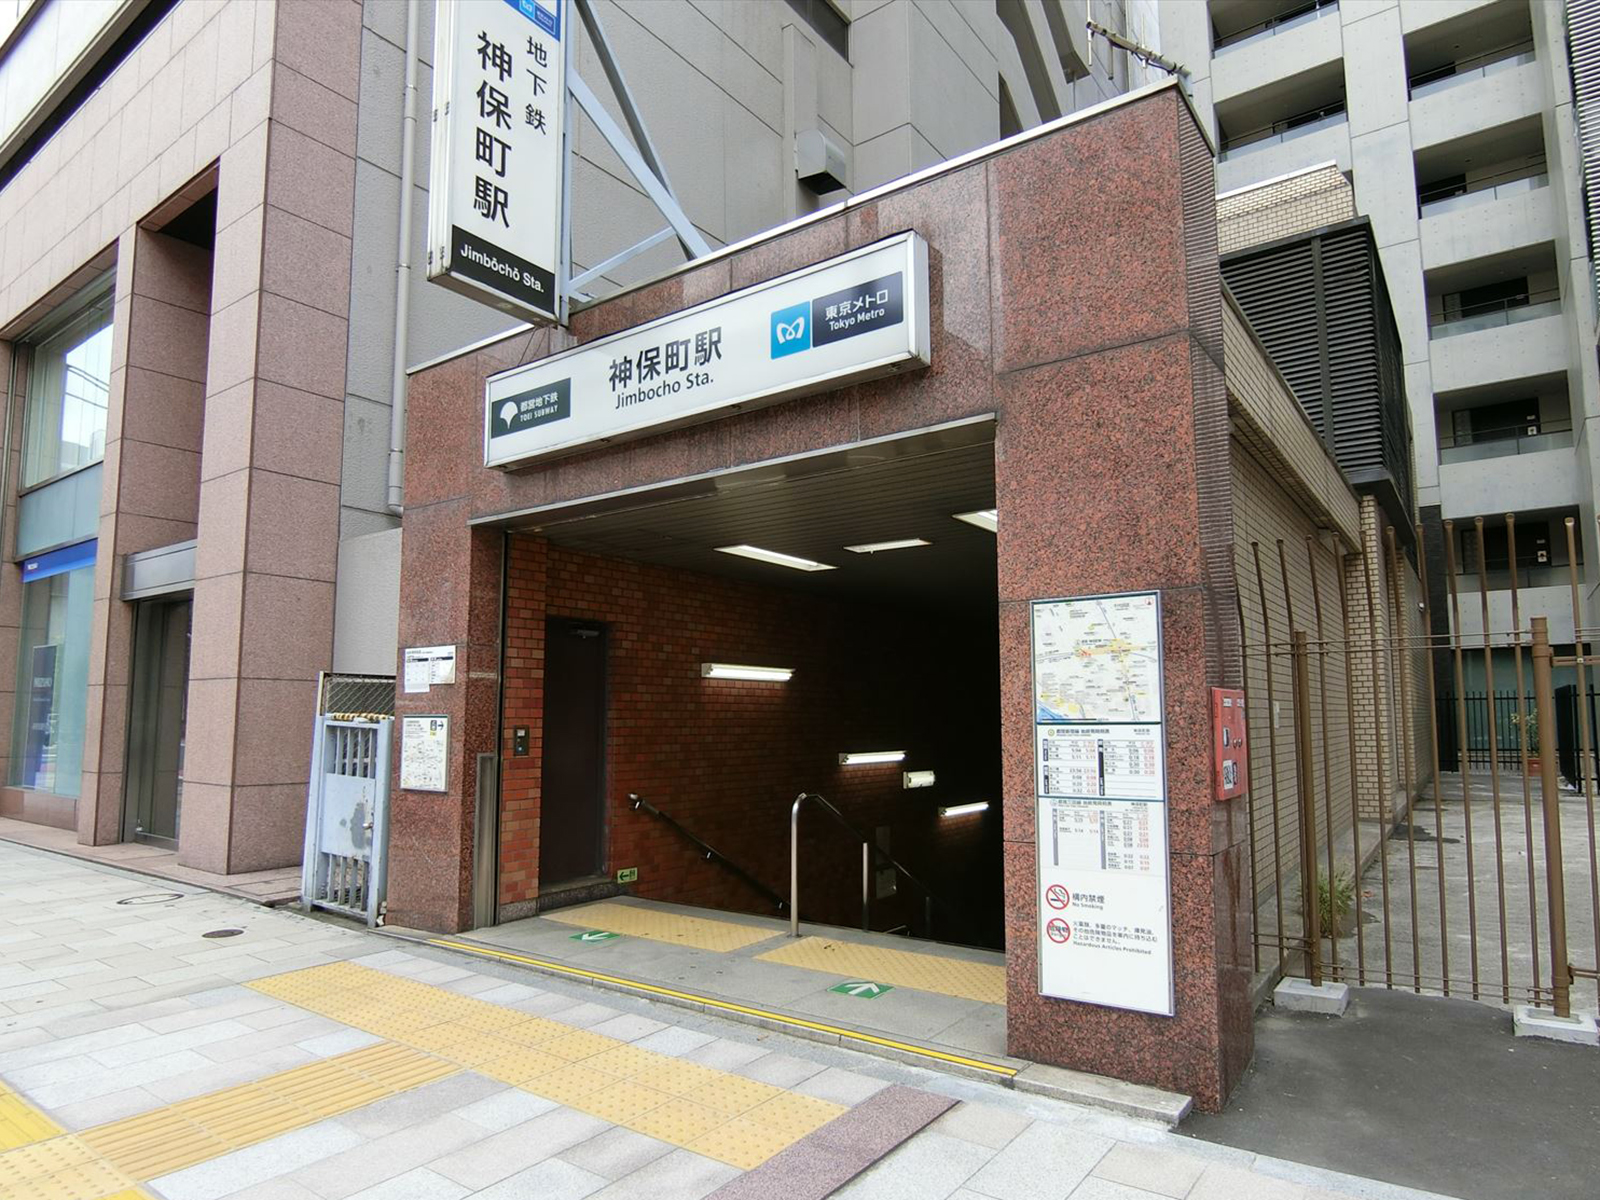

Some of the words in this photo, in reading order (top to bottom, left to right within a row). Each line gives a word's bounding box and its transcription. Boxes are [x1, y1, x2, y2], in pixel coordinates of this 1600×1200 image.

[525, 35, 548, 135] 地下鉄
[473, 30, 513, 229] 神保町駅
[460, 243, 521, 282] Jimbōchō
[522, 272, 545, 293] Sta.
[825, 289, 889, 321] 東京メトロ
[829, 317, 856, 332] Tokyo
[857, 307, 886, 323] Metro
[608, 326, 722, 392] 神保町駅
[520, 391, 559, 413] 都営地下鉄
[615, 379, 681, 410] Jimbocho
[686, 372, 714, 390] Sta.
[520, 412, 533, 423] TOEI
[534, 404, 559, 419] SUBWAY
[1072, 892, 1105, 904] 構内禁煙
